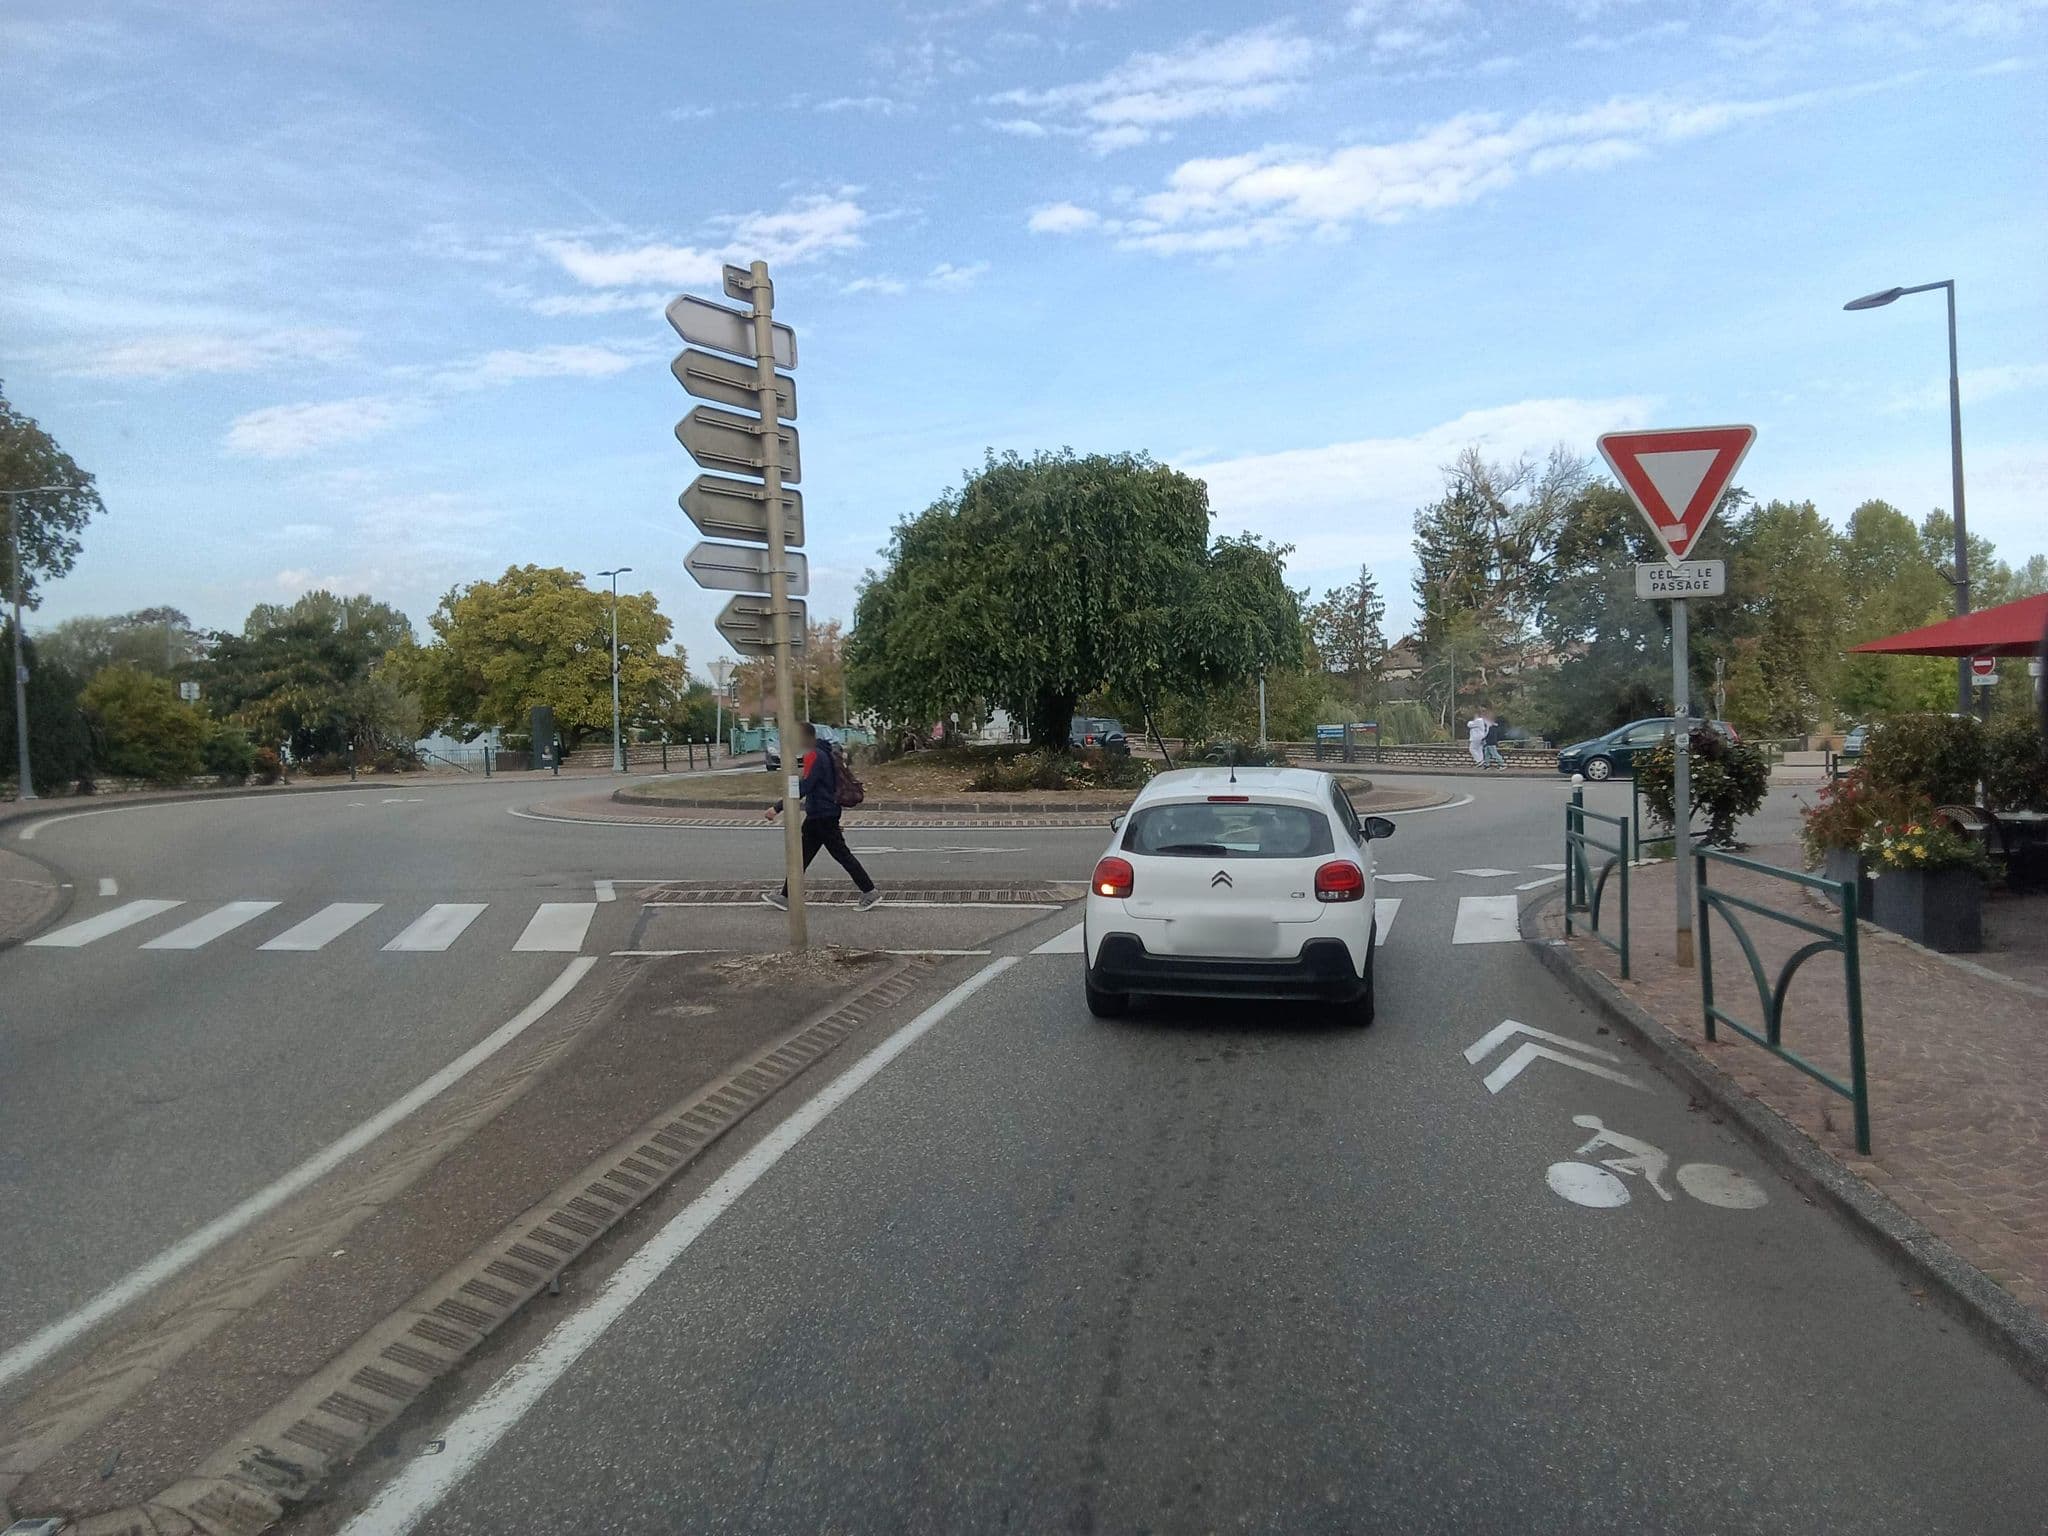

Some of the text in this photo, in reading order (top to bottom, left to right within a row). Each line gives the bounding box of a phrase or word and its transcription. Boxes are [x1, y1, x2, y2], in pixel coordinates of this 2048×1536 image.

[1650, 567, 1712, 580] CÉD LE
[1652, 580, 1710, 591] PASSAGE
